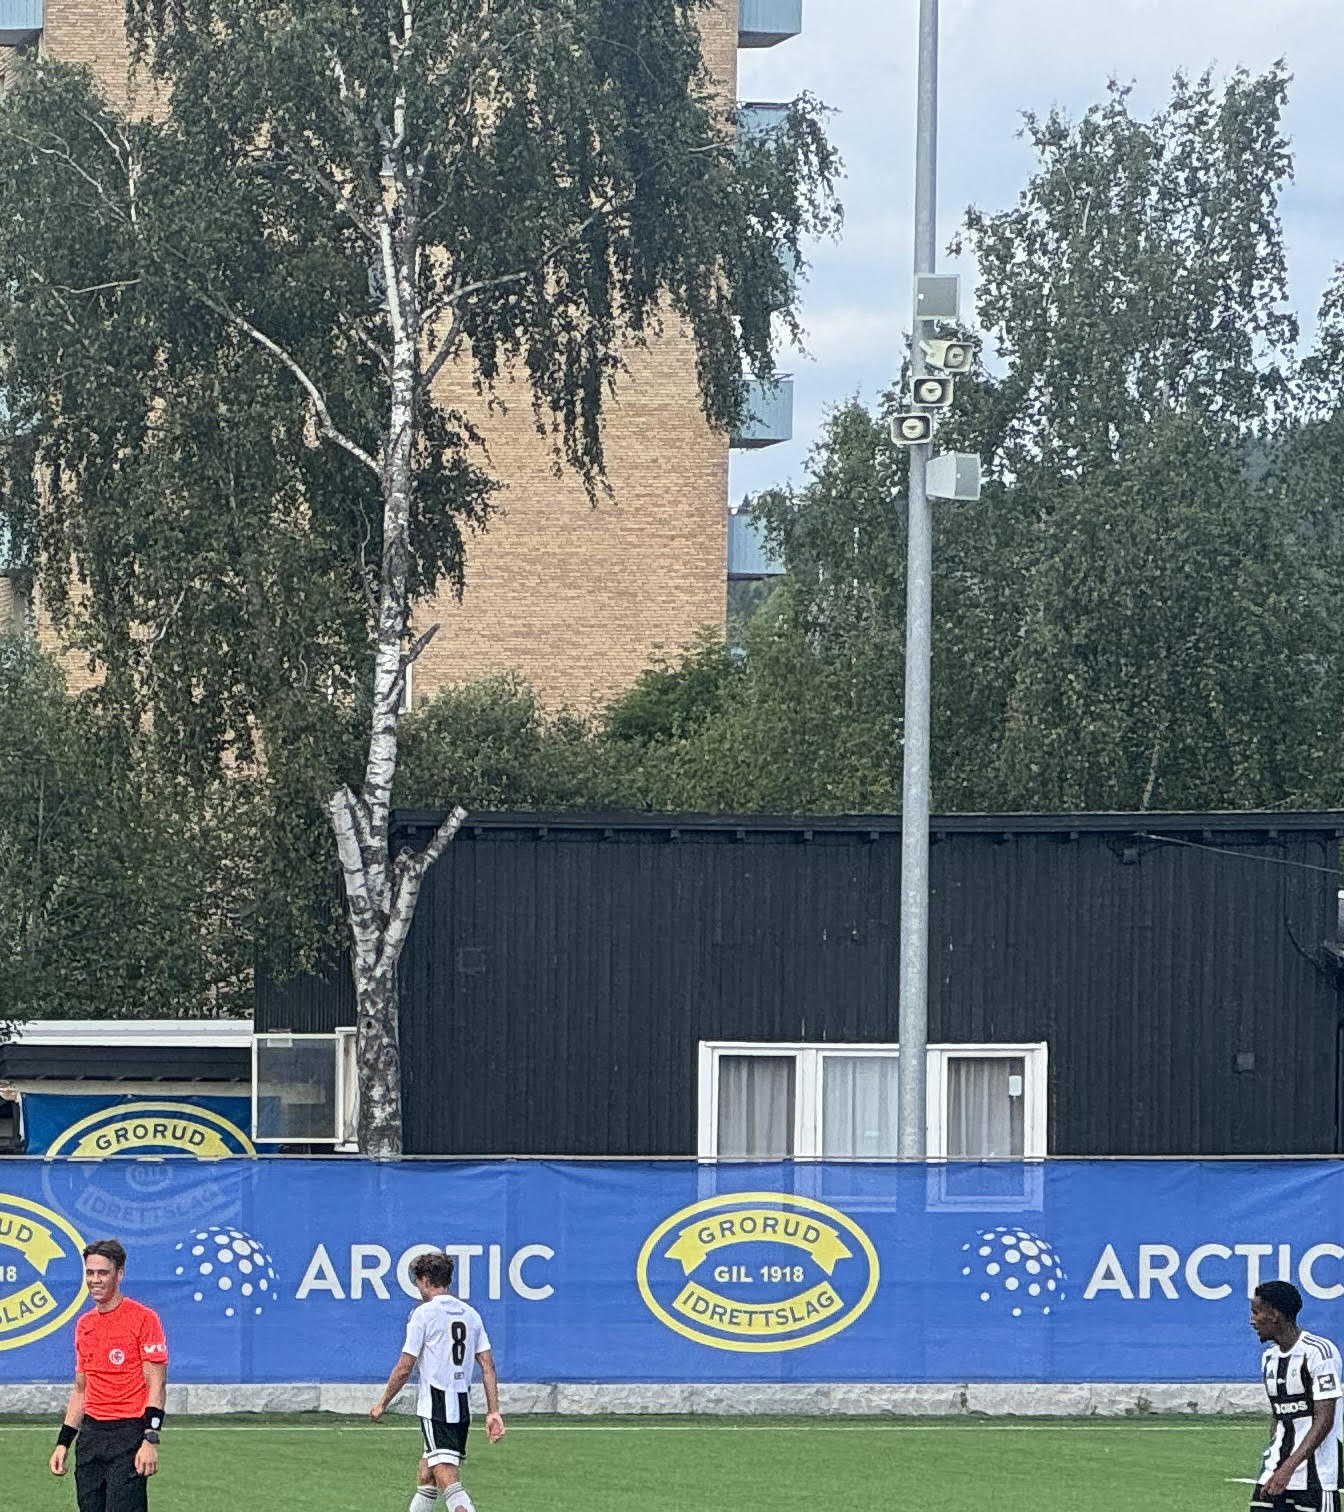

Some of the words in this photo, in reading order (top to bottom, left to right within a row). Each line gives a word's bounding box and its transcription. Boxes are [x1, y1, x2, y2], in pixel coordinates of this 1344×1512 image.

[96, 1123, 205, 1151] GRORUD
[698, 1216, 821, 1244] GRORUD
[295, 1243, 555, 1300] ARCTIC
[714, 1266, 754, 1282] GIL
[760, 1266, 805, 1282] 1918
[1083, 1243, 1344, 1300] ARCTIC
[682, 1290, 835, 1328] IDRETTSLAG
[451, 1321, 467, 1367] 8
